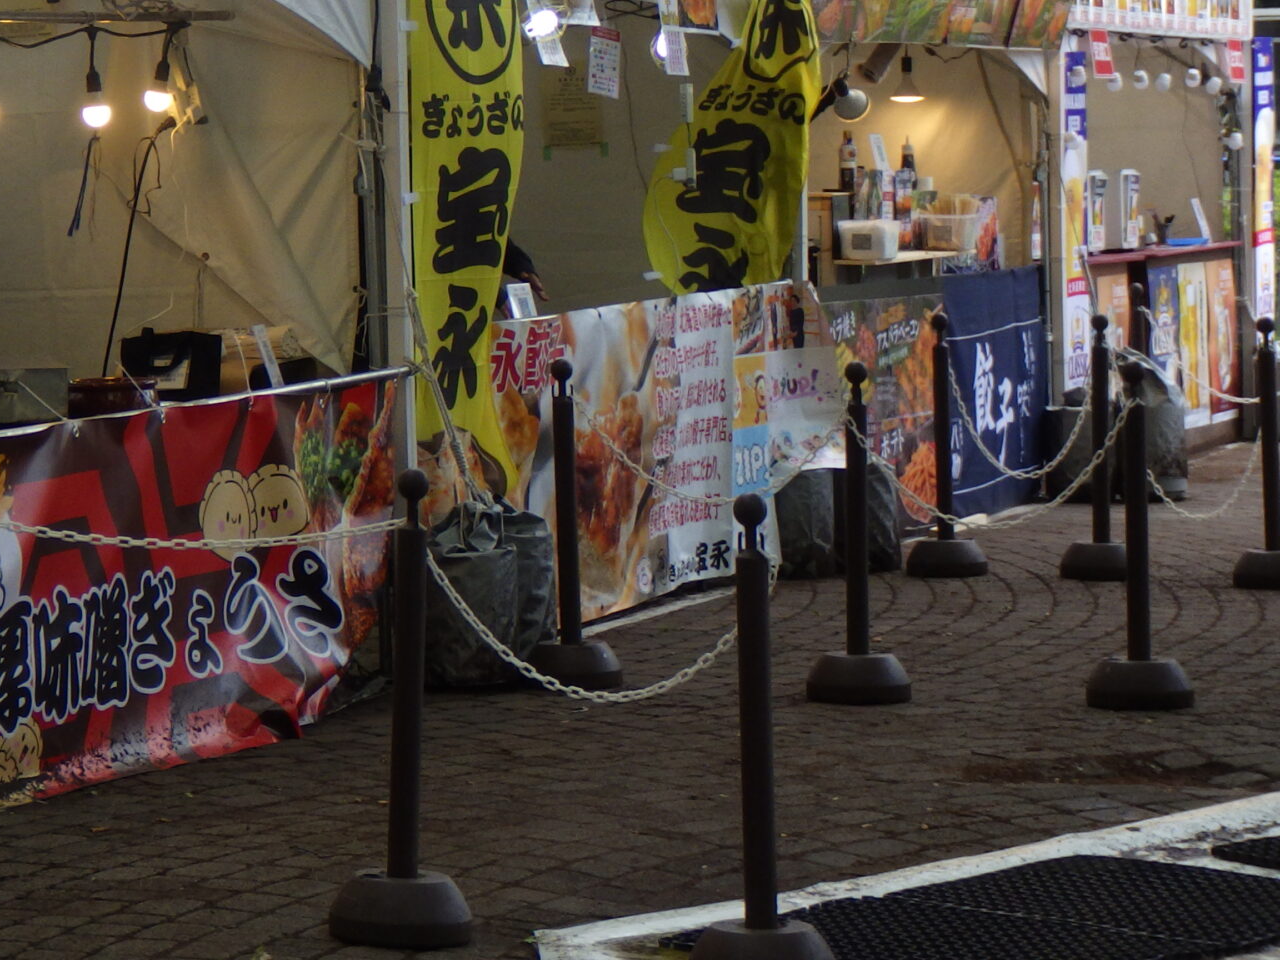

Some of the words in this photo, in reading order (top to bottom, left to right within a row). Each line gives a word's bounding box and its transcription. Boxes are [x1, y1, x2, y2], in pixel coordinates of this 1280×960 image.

[421, 91, 525, 140] ぎょうざの
[699, 86, 807, 126] ぎょうざの
